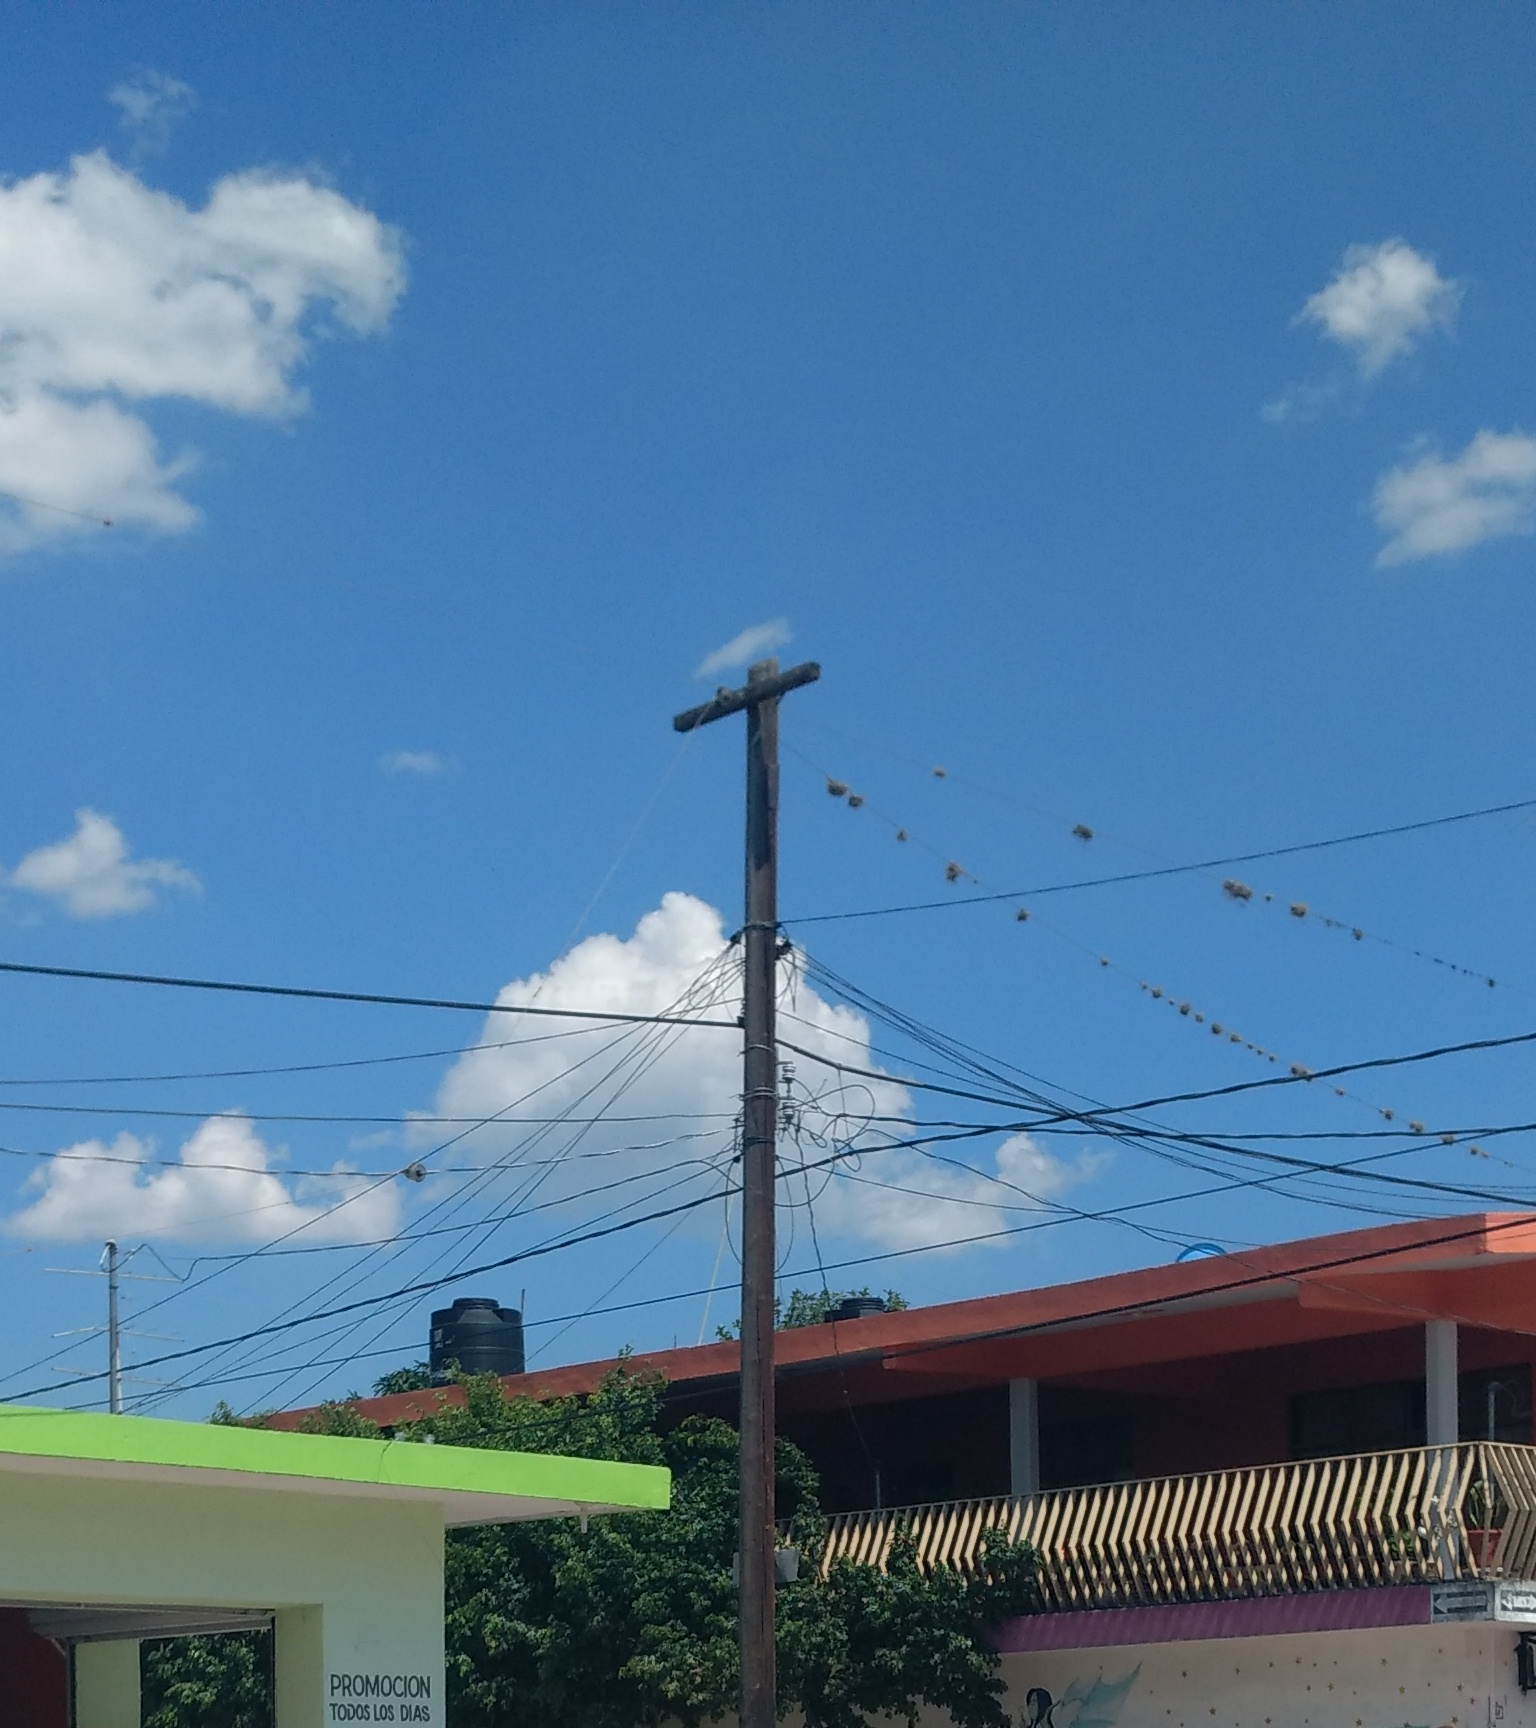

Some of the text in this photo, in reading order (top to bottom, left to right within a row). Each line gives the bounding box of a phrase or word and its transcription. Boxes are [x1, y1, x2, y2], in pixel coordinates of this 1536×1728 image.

[330, 1674, 431, 1698] PROMOCION
[329, 1703, 431, 1722] TODOS LOS DIAS
